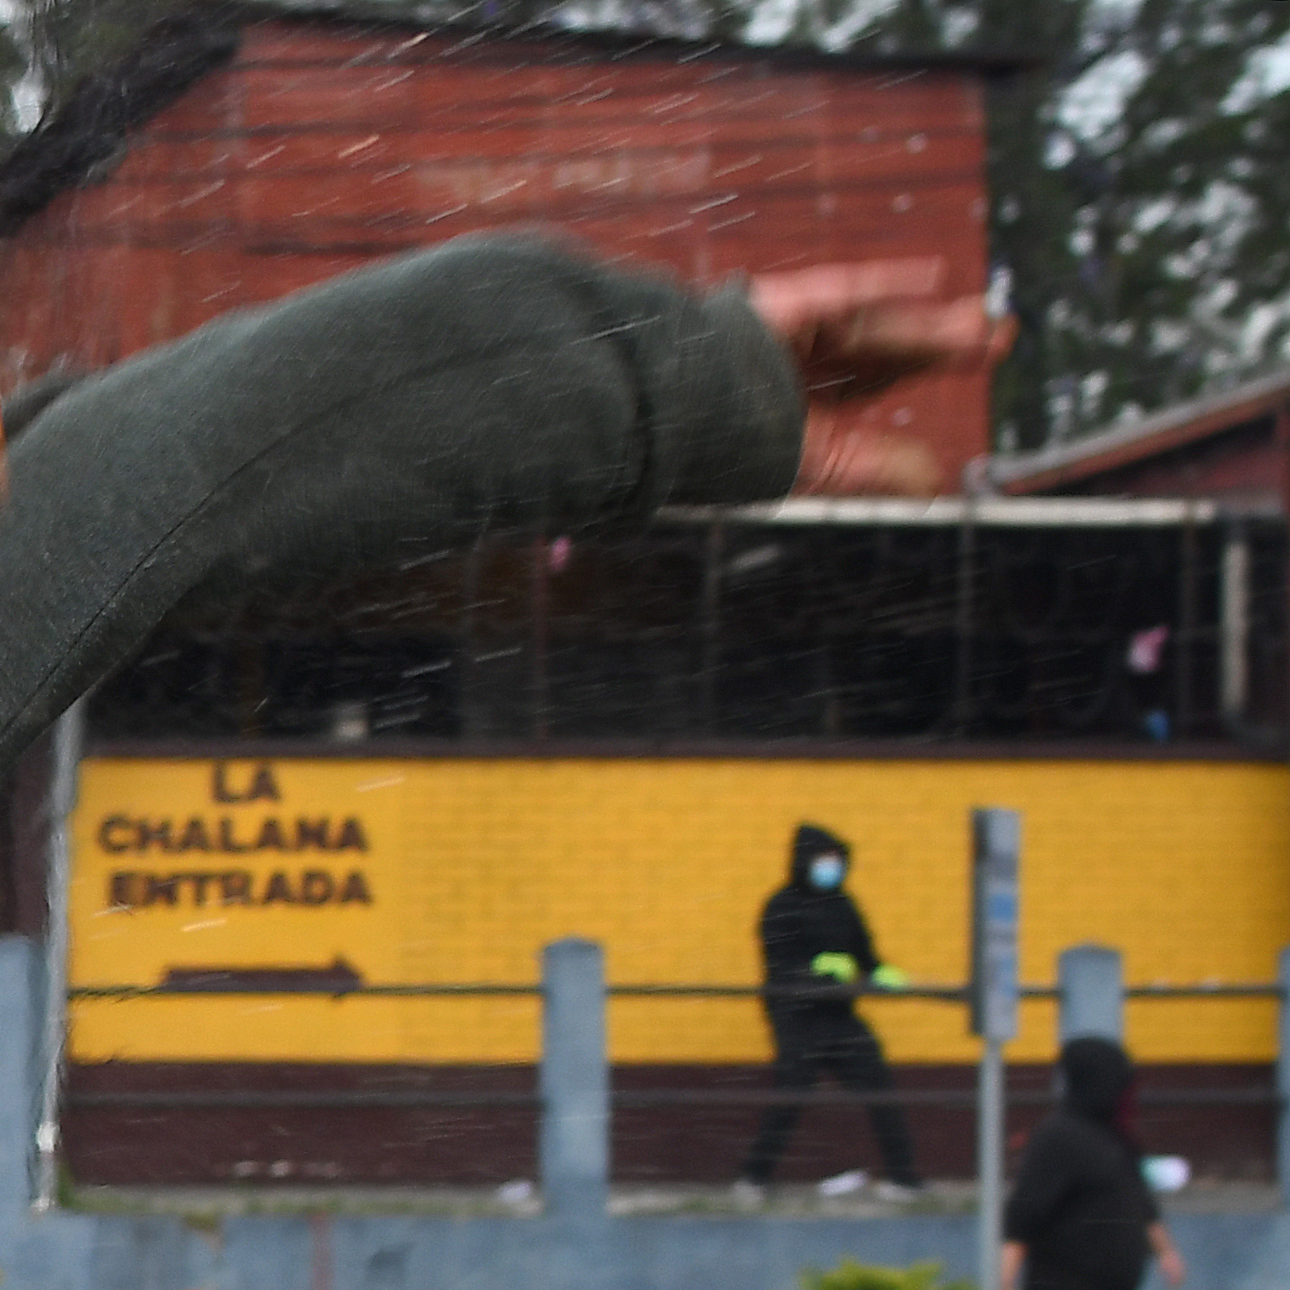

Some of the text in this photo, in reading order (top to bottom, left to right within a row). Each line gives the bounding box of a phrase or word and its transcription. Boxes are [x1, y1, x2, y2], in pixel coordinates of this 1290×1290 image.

[213, 758, 281, 804] LA
[98, 814, 370, 853] CHALANA
[107, 869, 373, 907] ENTRADA
